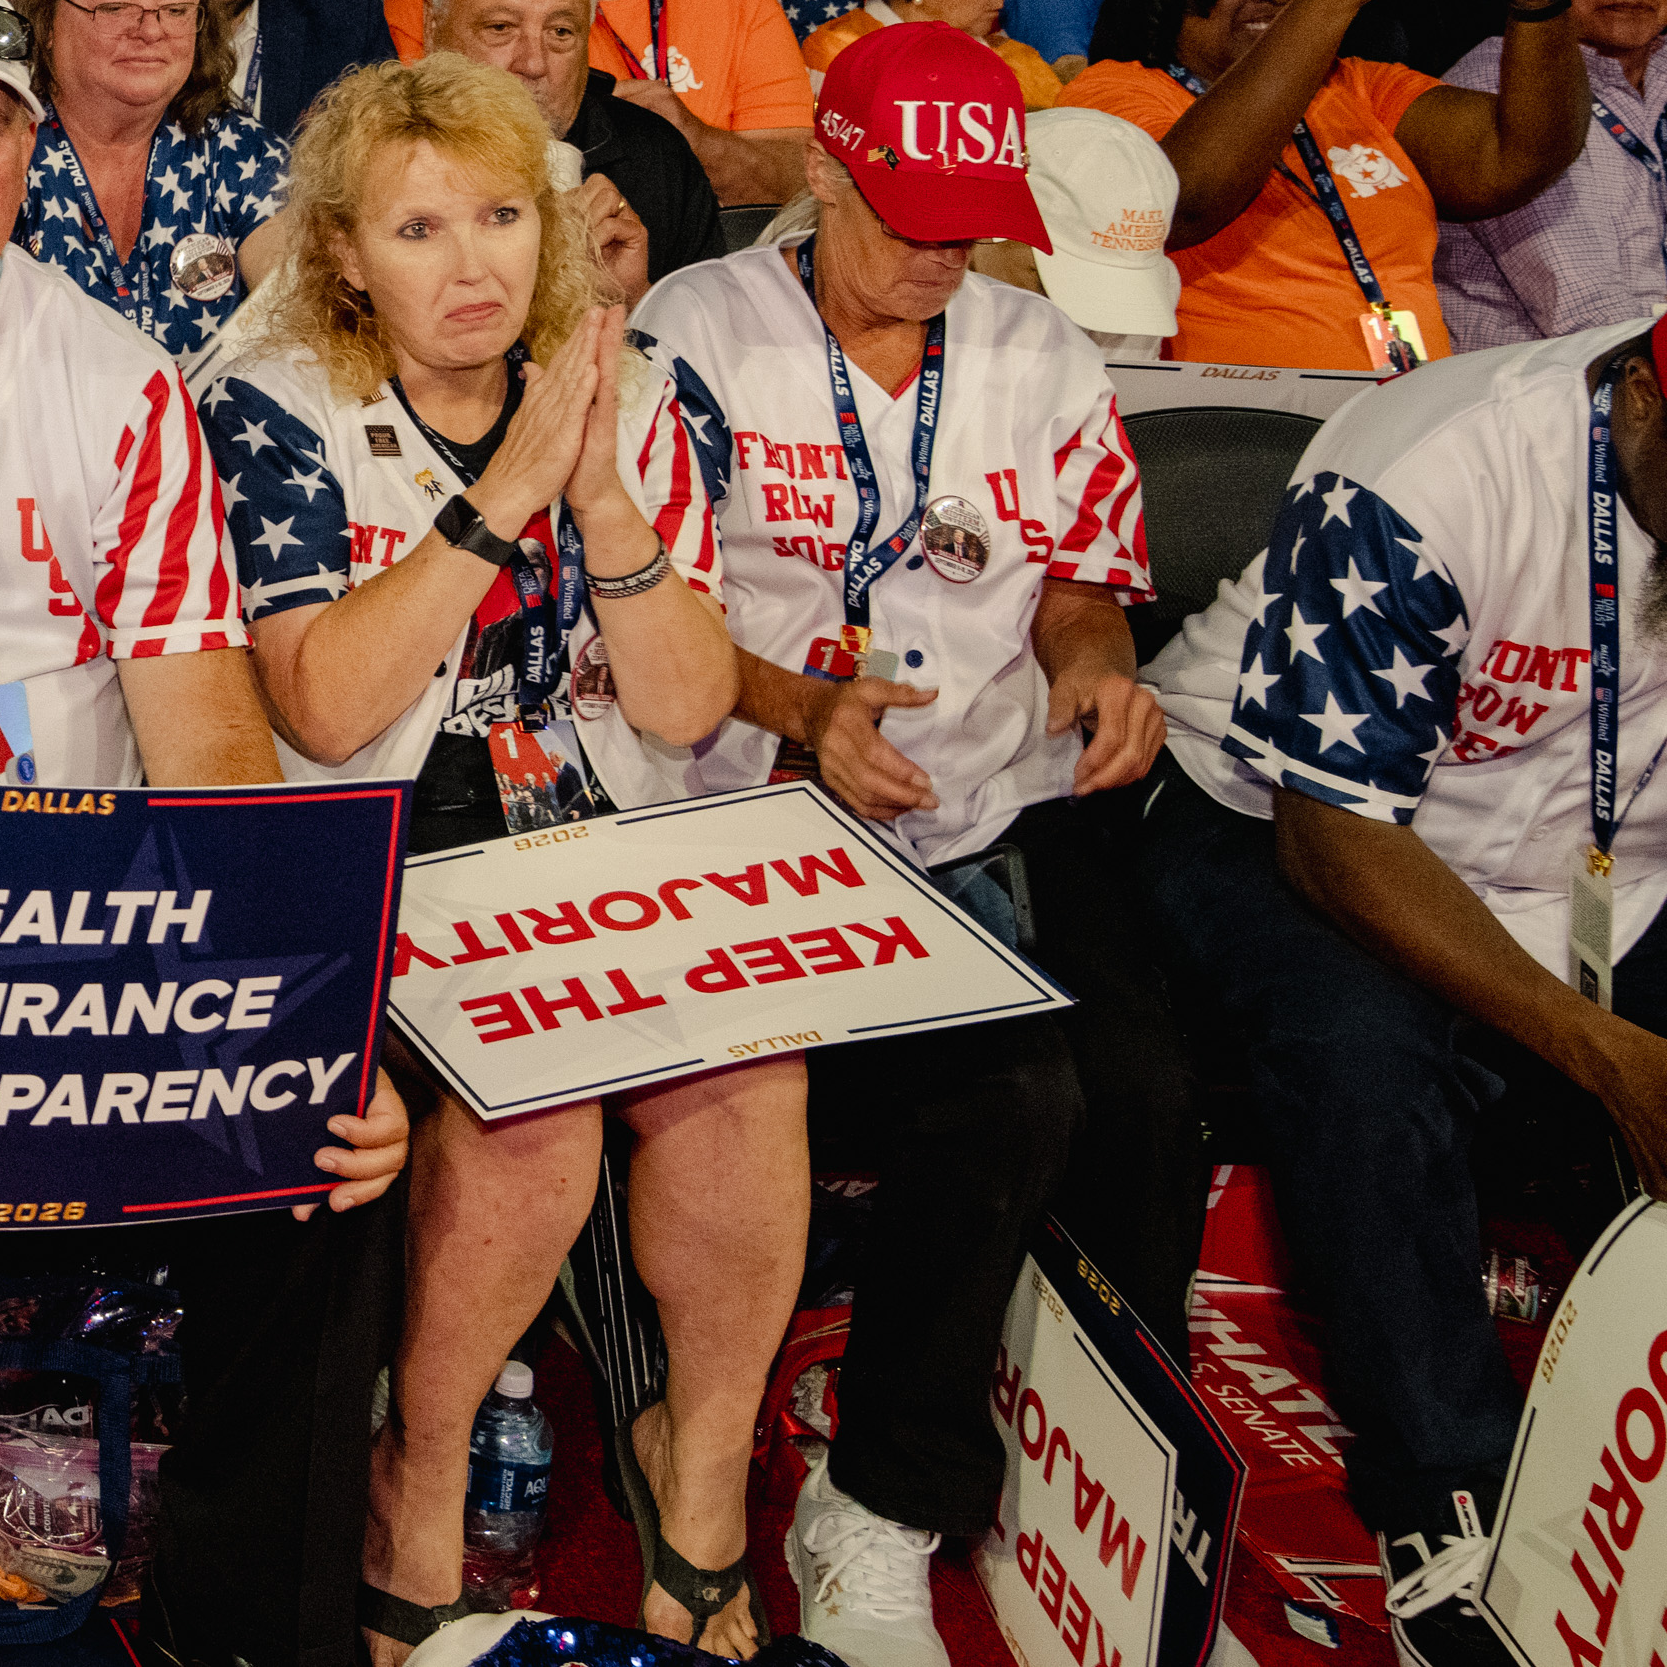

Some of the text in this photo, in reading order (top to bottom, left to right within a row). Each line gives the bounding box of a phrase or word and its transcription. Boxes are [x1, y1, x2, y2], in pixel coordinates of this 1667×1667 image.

[821, 110, 866, 154] 45/47
[894, 100, 1025, 169] USA
[919, 368, 938, 428] DALLAS
[1201, 367, 1281, 381] DALLAS
[1592, 443, 1608, 484] WinRed
[762, 483, 833, 525] ROW
[1592, 490, 1613, 565] DALLAS
[527, 626, 545, 683] DALLAS
[499, 729, 518, 760] 1
[2, 791, 116, 815] DALLAS
[515, 825, 589, 851] 2026
[393, 848, 867, 976] MAJORITY
[460, 915, 931, 1044] KEEP THE
[727, 1030, 824, 1059] DALLAS
[1077, 1257, 1122, 1316] 2026
[1540, 1298, 1580, 1384] 2026
[1206, 1386, 1316, 1472] SENATE
